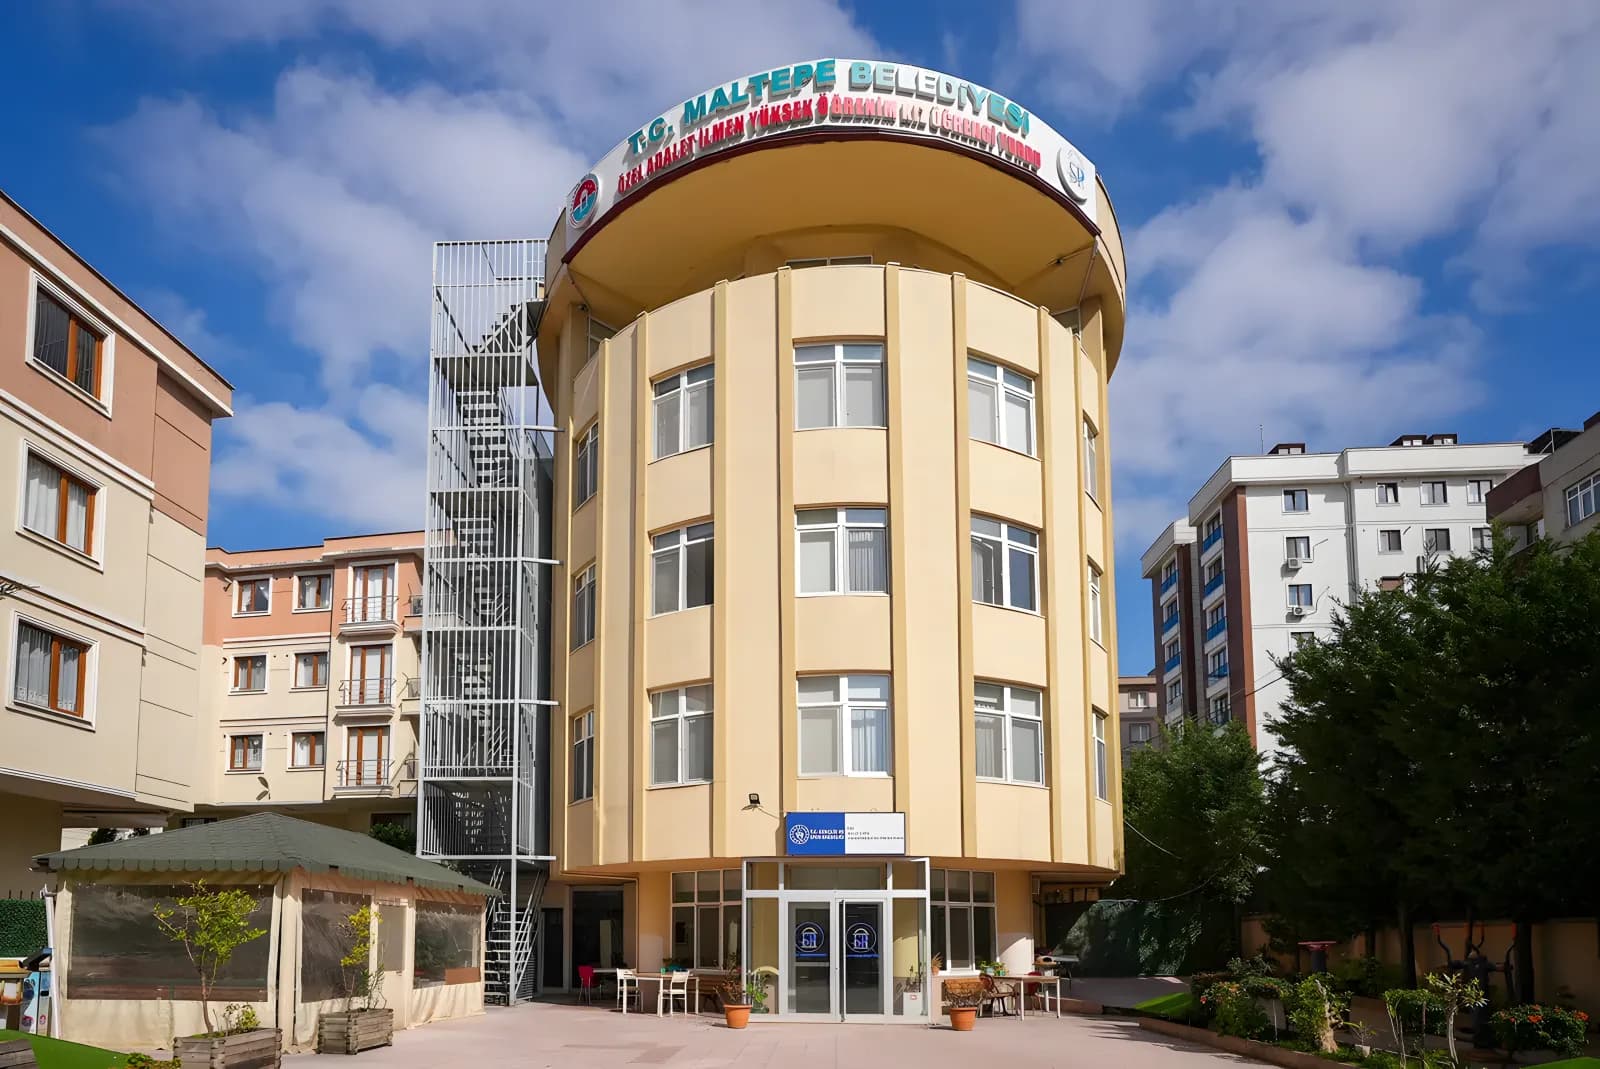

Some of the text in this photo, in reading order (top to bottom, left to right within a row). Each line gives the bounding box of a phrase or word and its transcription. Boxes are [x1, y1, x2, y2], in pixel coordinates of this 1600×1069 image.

[684, 59, 835, 123] MALTEPE
[647, 134, 696, 176] ADALET
[749, 99, 813, 127] YÜKSEK
